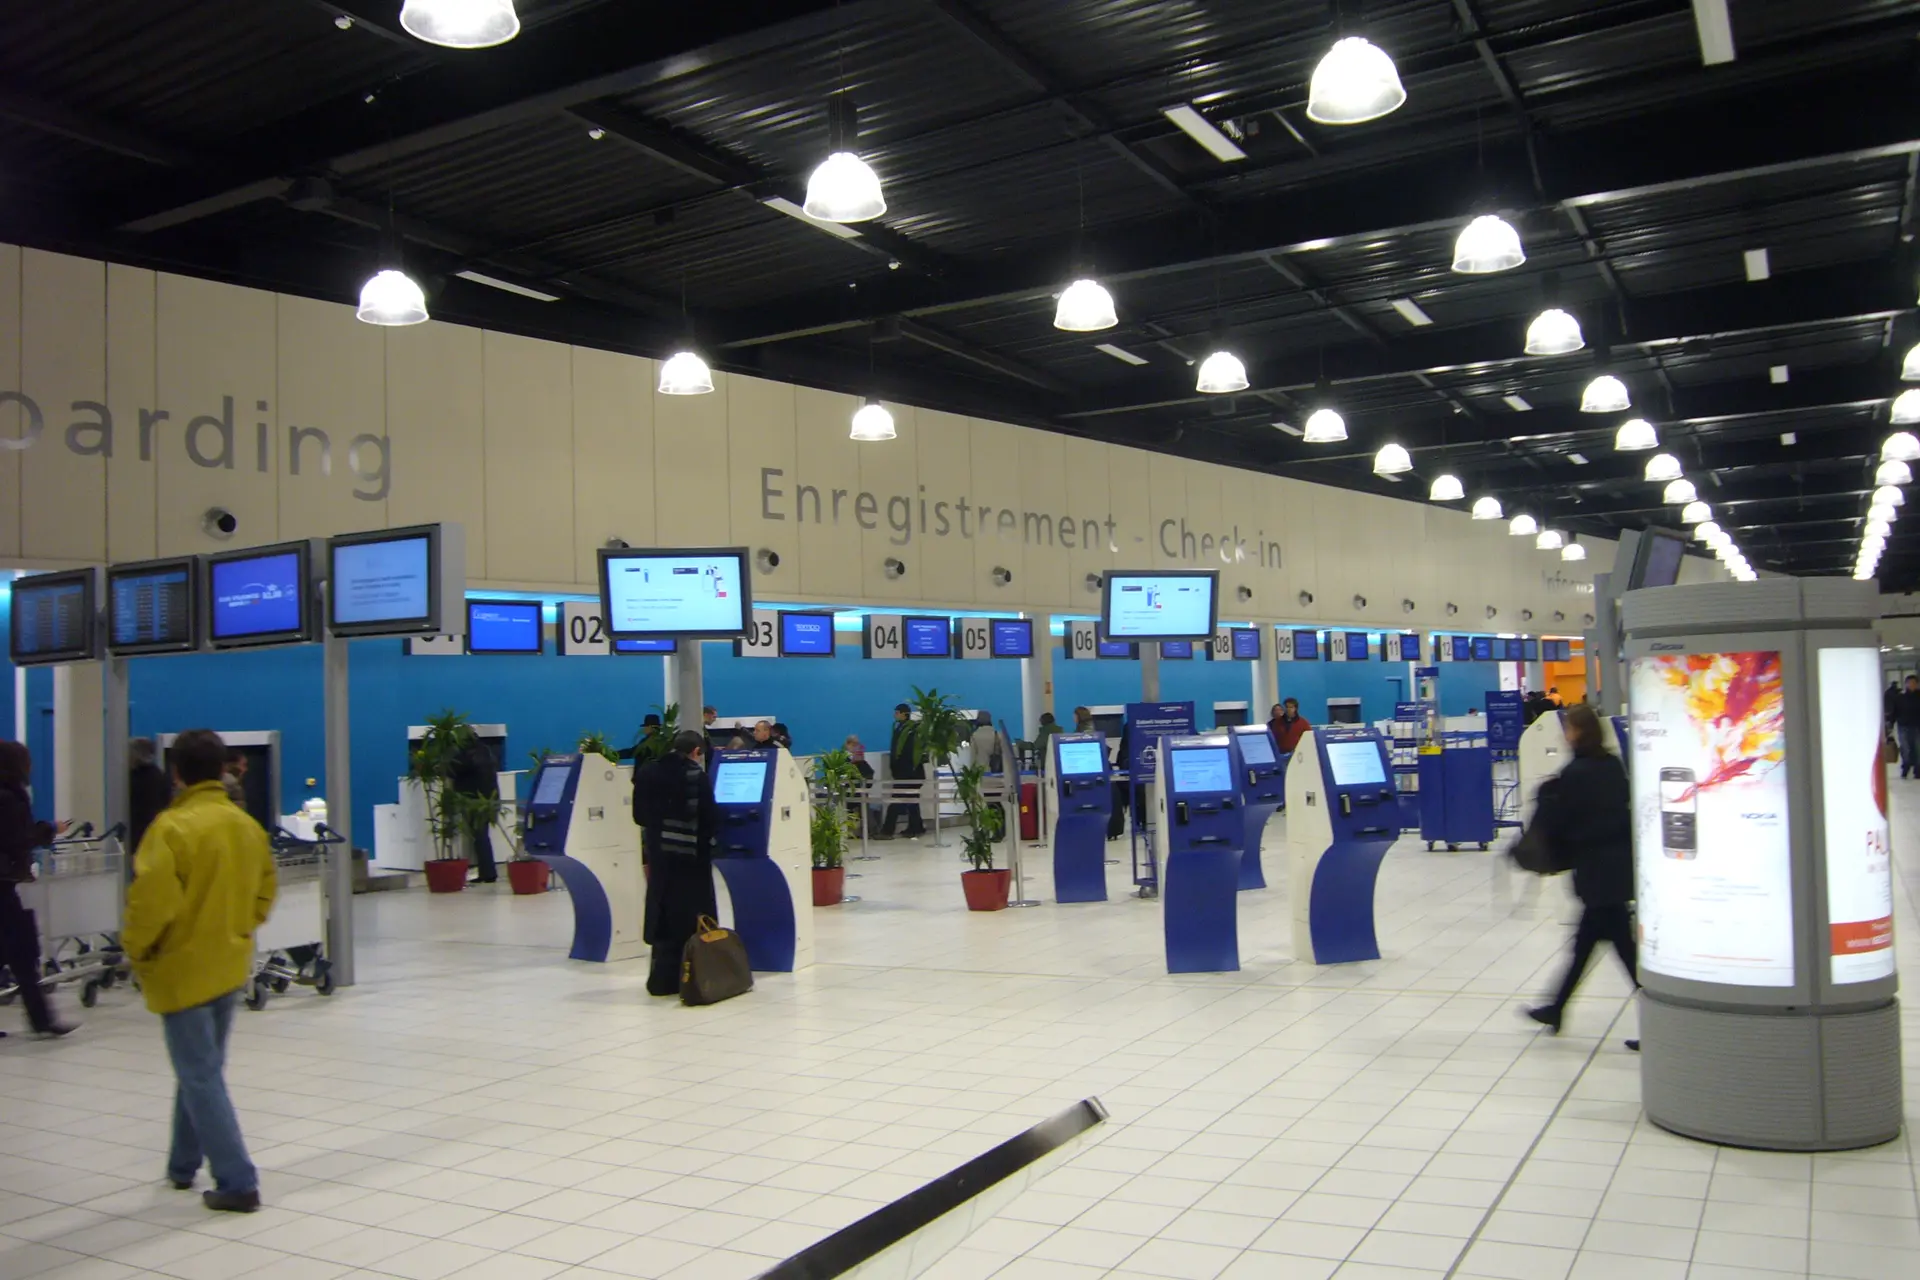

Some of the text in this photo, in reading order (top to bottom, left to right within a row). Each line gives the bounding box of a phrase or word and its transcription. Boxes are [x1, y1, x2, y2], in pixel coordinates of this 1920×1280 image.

[761, 467, 1118, 552] Enregistrement
[1159, 517, 1282, 569] Check-in
[570, 615, 604, 644] 02
[747, 621, 773, 647] 03
[874, 625, 899, 650] 04
[965, 627, 987, 651] 05
[1075, 630, 1093, 651] 06
[1215, 635, 1230, 653] 08
[1278, 637, 1292, 654] 09
[1333, 638, 1344, 654] 10
[1388, 639, 1399, 655] 11
[1442, 641, 1452, 656] 12
